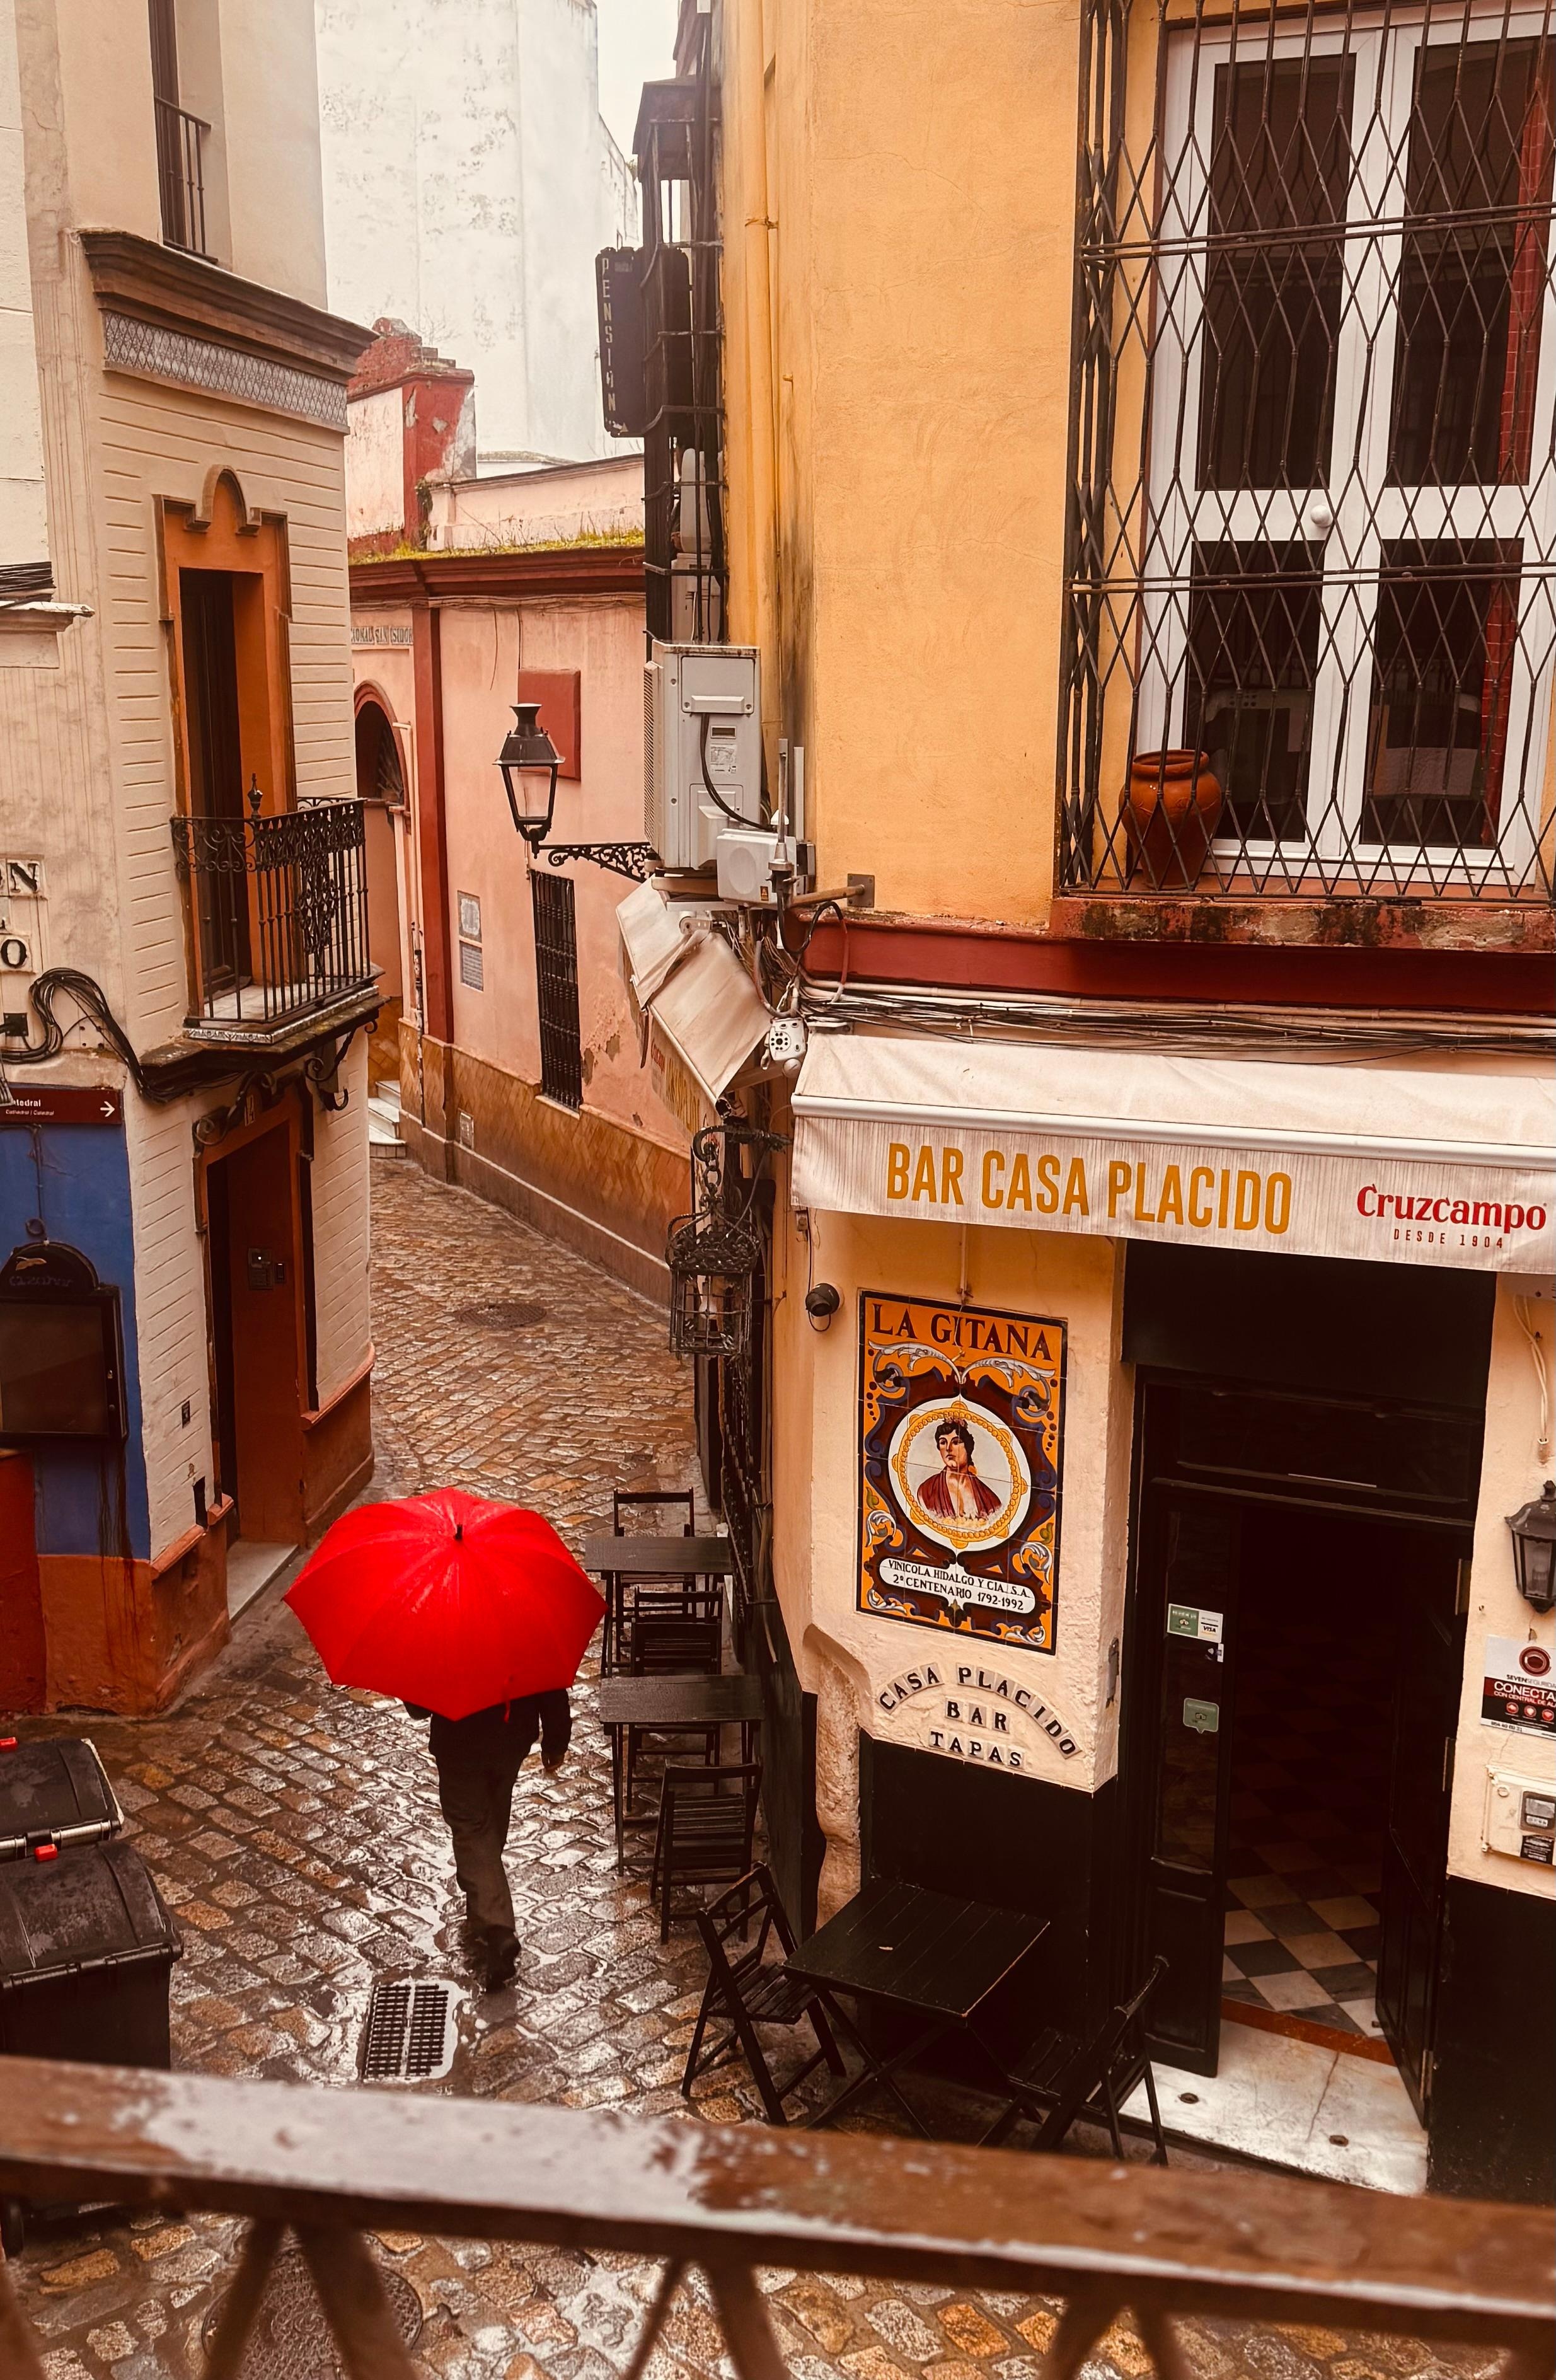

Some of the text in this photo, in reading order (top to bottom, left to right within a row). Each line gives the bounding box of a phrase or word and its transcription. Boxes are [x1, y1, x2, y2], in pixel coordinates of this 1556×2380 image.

[887, 1143, 1291, 1234] BAR CASA PLACIDO
[1357, 1184, 1547, 1234] Cruzcampo
[1394, 1228, 1502, 1249] DESDE 1904
[872, 1303, 1054, 1361] LA GITANA
[889, 1559, 930, 1577] VINICOLA
[934, 1569, 974, 1586] HIDALGO
[977, 1579, 984, 1588] Y
[906, 1577, 972, 1600] CENTENARIO
[977, 1592, 1023, 1610] 1792-1992
[880, 1667, 1076, 1754] CASA PLACIDO
[947, 1701, 1007, 1731] BAR
[1509, 1694, 1536, 1704] CENTRAL
[931, 1731, 1022, 1766] TAPAS
